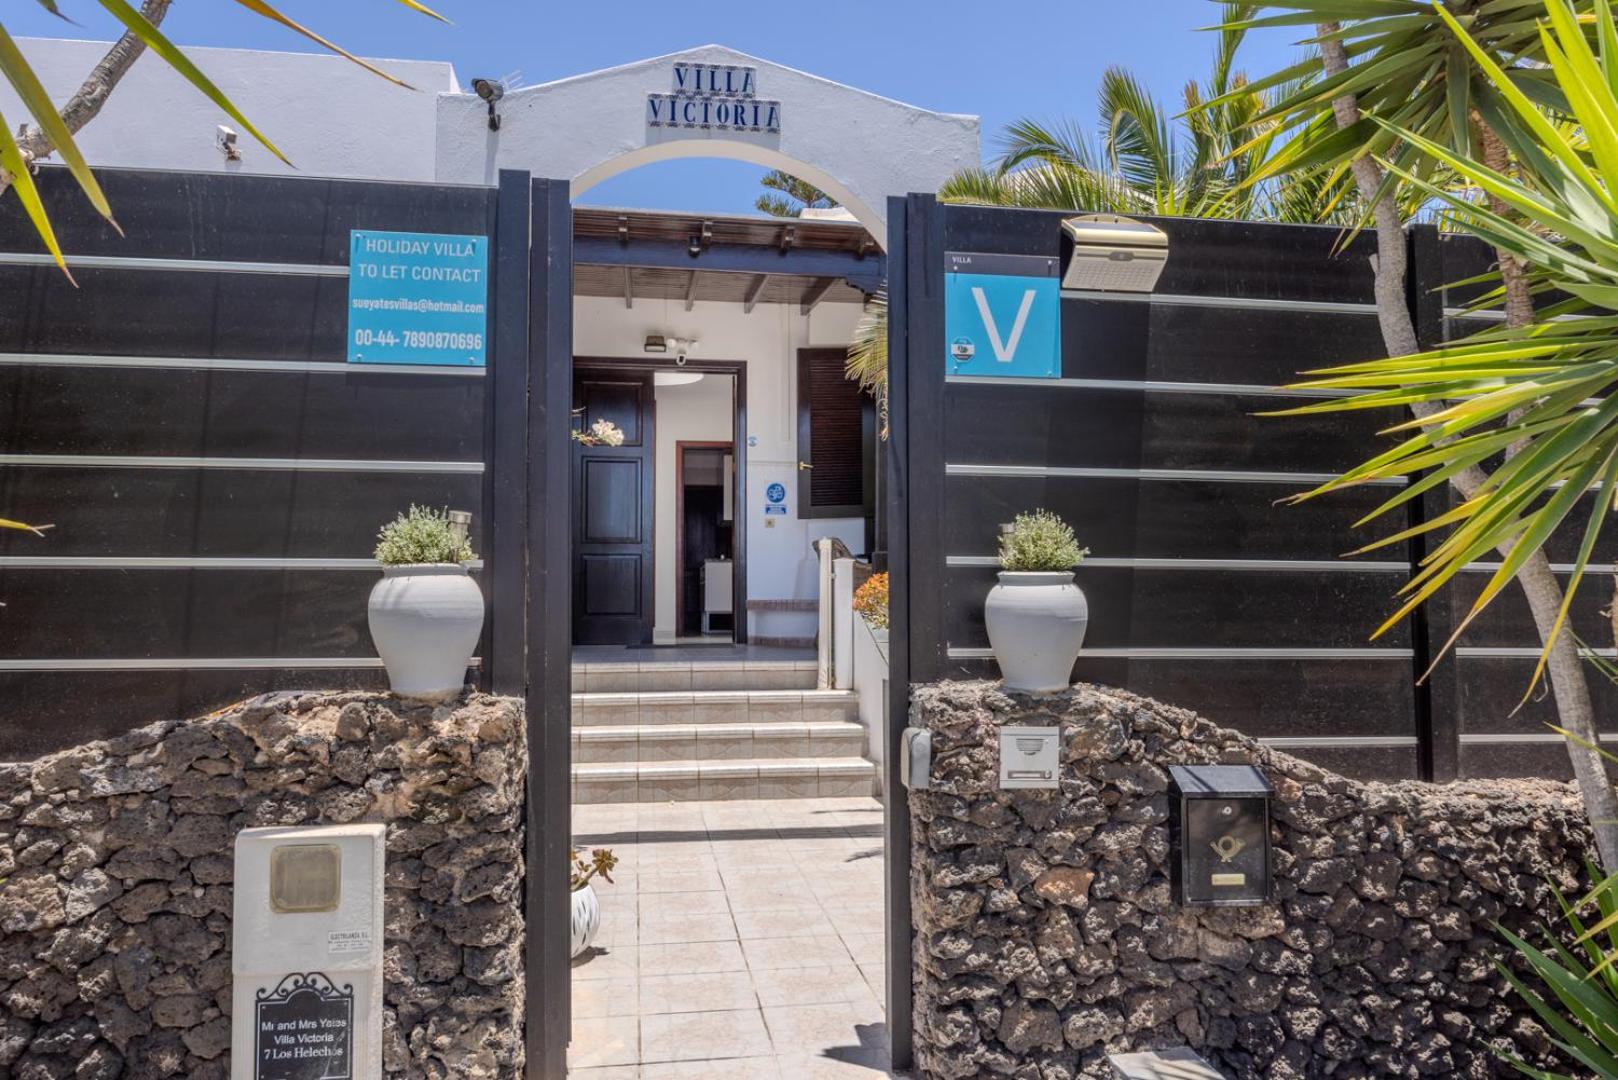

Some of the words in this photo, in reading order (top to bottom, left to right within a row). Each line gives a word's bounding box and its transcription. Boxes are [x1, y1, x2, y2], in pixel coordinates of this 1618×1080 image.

[674, 67, 756, 93] VILLA
[649, 99, 780, 127] VICTORIA
[366, 239, 430, 255] HOLIDAY
[433, 242, 475, 257] VILLA
[952, 256, 972, 264] VILLA
[358, 263, 378, 278] TO
[382, 264, 408, 279] LET
[411, 266, 481, 282] CONTACT
[352, 298, 485, 314] sueyatesvillas@hotmail.com
[971, 286, 1037, 362] V
[402, 331, 482, 350] 7890870696
[277, 1020, 297, 1030] and
[299, 1019, 318, 1029] Mrs
[273, 1034, 295, 1045] Villa
[297, 1032, 334, 1043] Victoria
[264, 1049, 271, 1060] 7
[272, 1048, 292, 1059] Los
